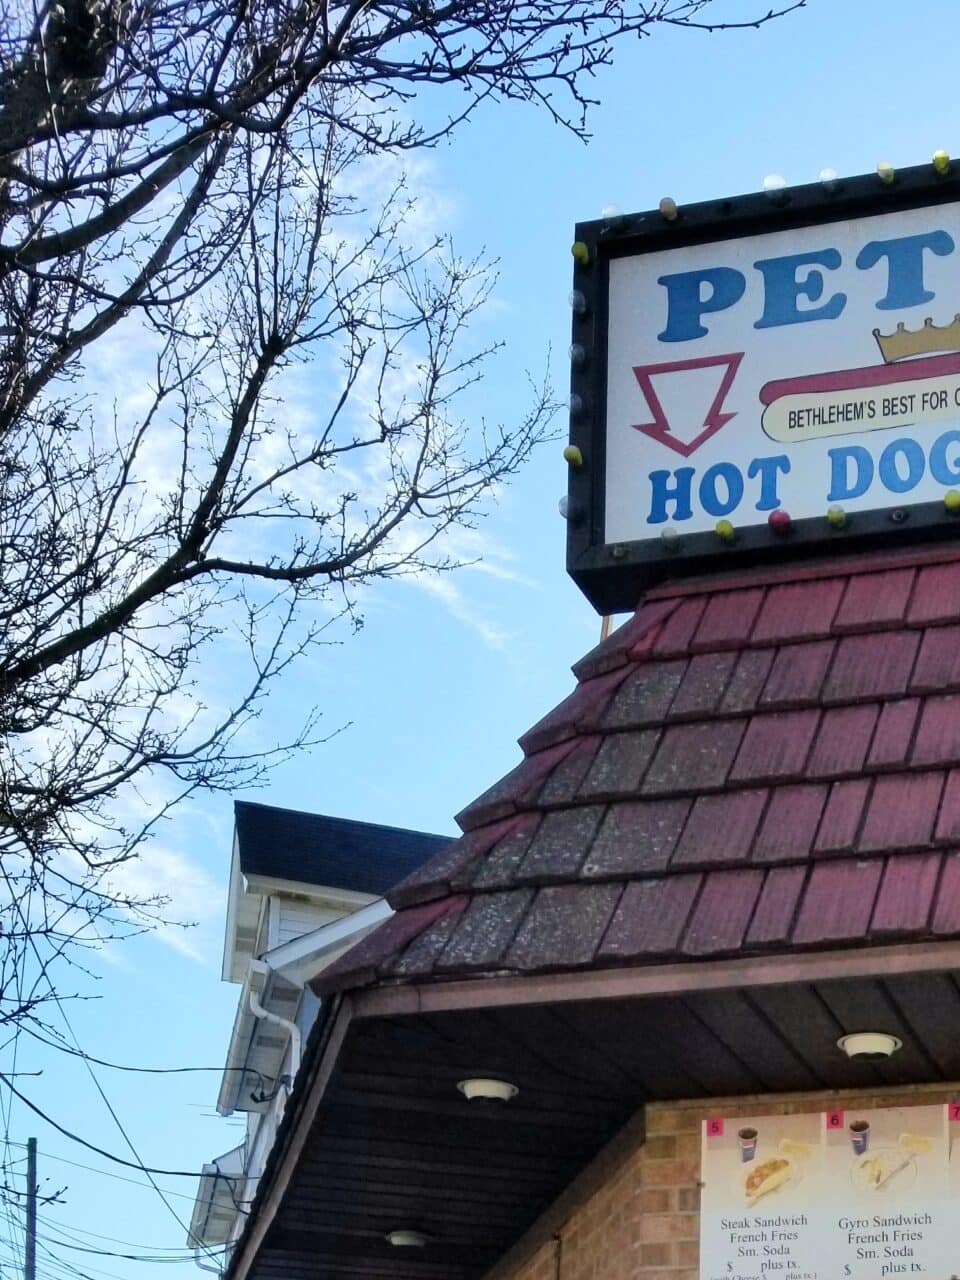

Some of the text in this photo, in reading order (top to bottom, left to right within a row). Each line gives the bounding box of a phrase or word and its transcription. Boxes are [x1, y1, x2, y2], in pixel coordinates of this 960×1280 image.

[787, 399, 877, 430] BETHLEHEM'S
[882, 394, 916, 417] BEST
[921, 390, 948, 411] FOR
[646, 454, 791, 525] HOT
[953, 1106, 960, 1118] 7
[711, 1121, 720, 1134] 5
[830, 1114, 840, 1127] 6
[720, 1214, 808, 1230] Steak Sandwich
[838, 1212, 932, 1232] Gyro Sandwich
[730, 1229, 799, 1243] French Fries
[848, 1229, 923, 1244] French Fries
[737, 1244, 790, 1257] Sm. Soda
[856, 1245, 914, 1259] Sm. Soda
[760, 1259, 784, 1273] plus
[881, 1261, 907, 1277] plus
